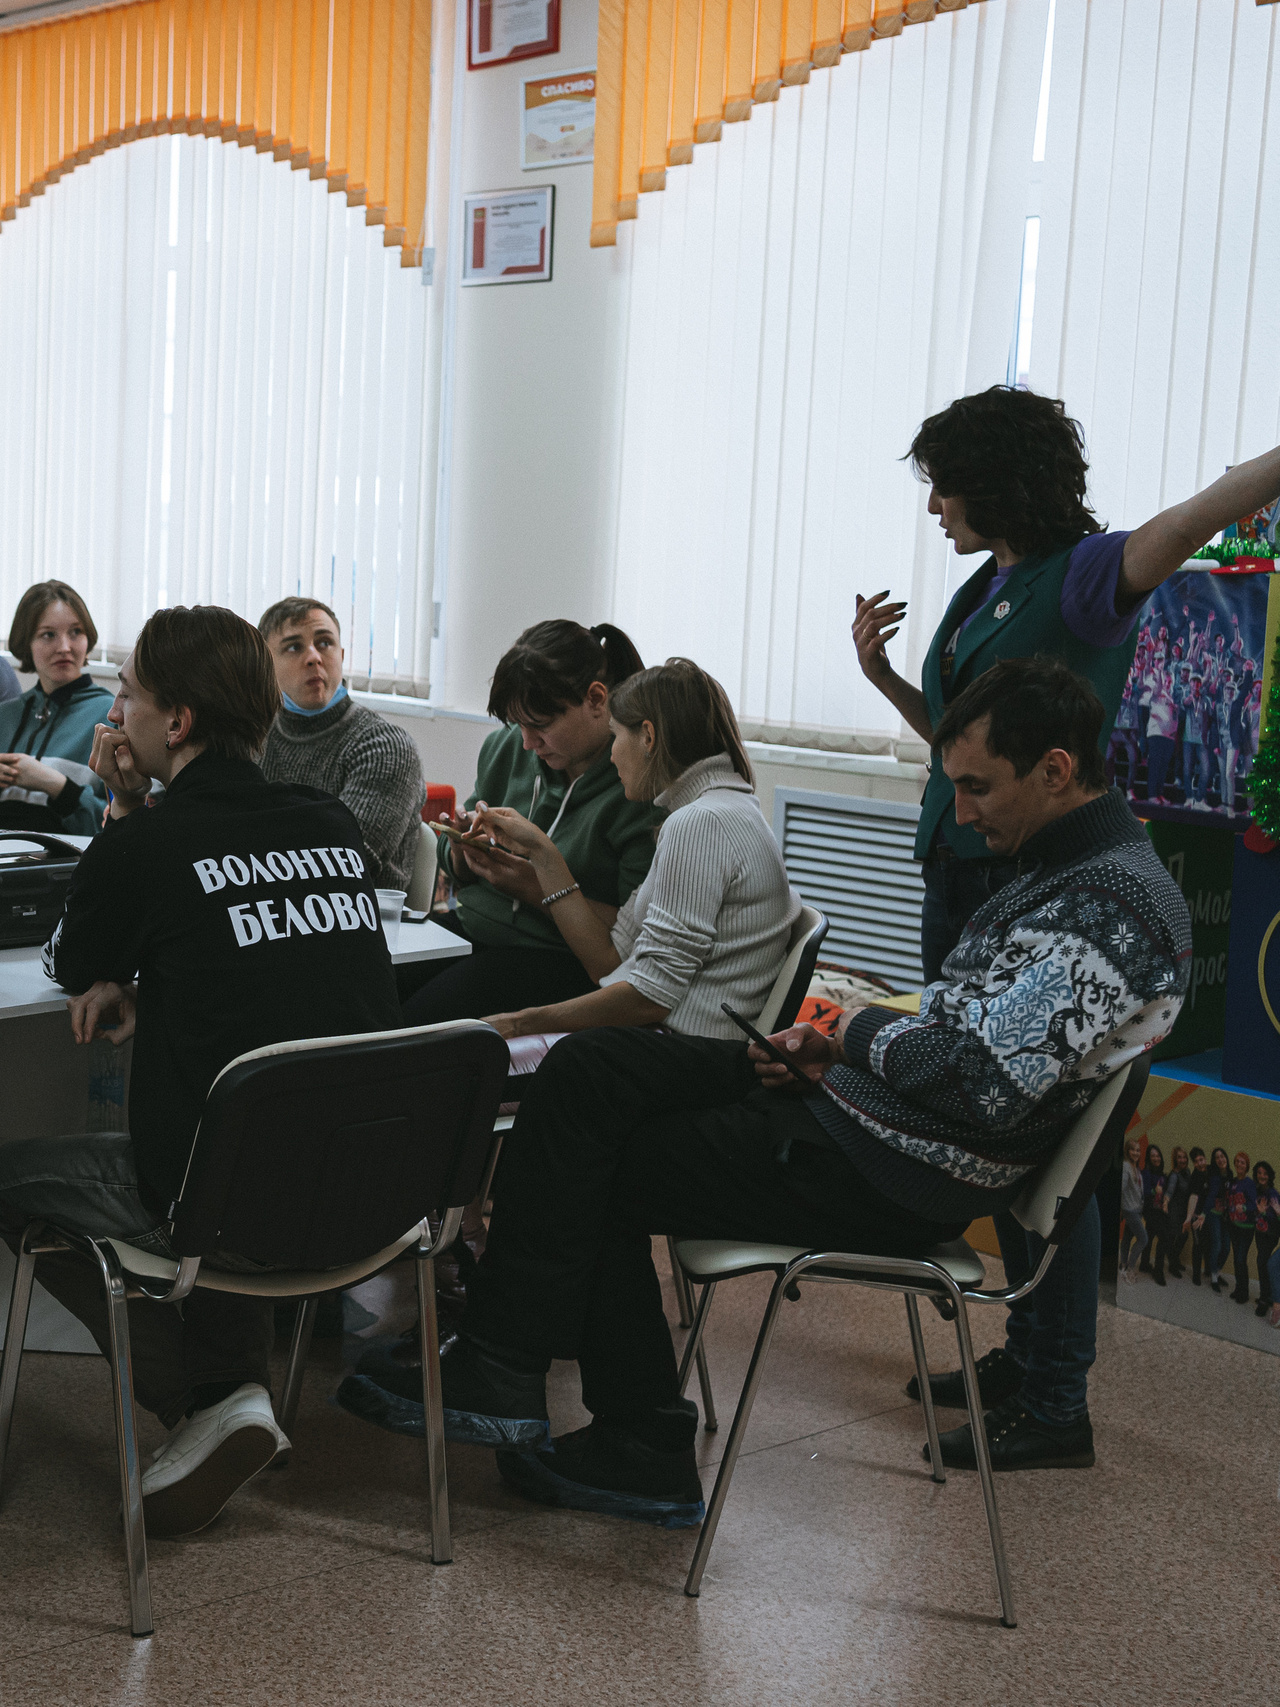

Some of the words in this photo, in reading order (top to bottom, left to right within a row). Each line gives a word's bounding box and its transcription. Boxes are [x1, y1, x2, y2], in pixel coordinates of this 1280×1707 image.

[541, 78, 595, 97] СПАСИБО
[192, 846, 365, 894] ВОЛОНТЕР
[227, 892, 378, 948] БЕЛОВО
